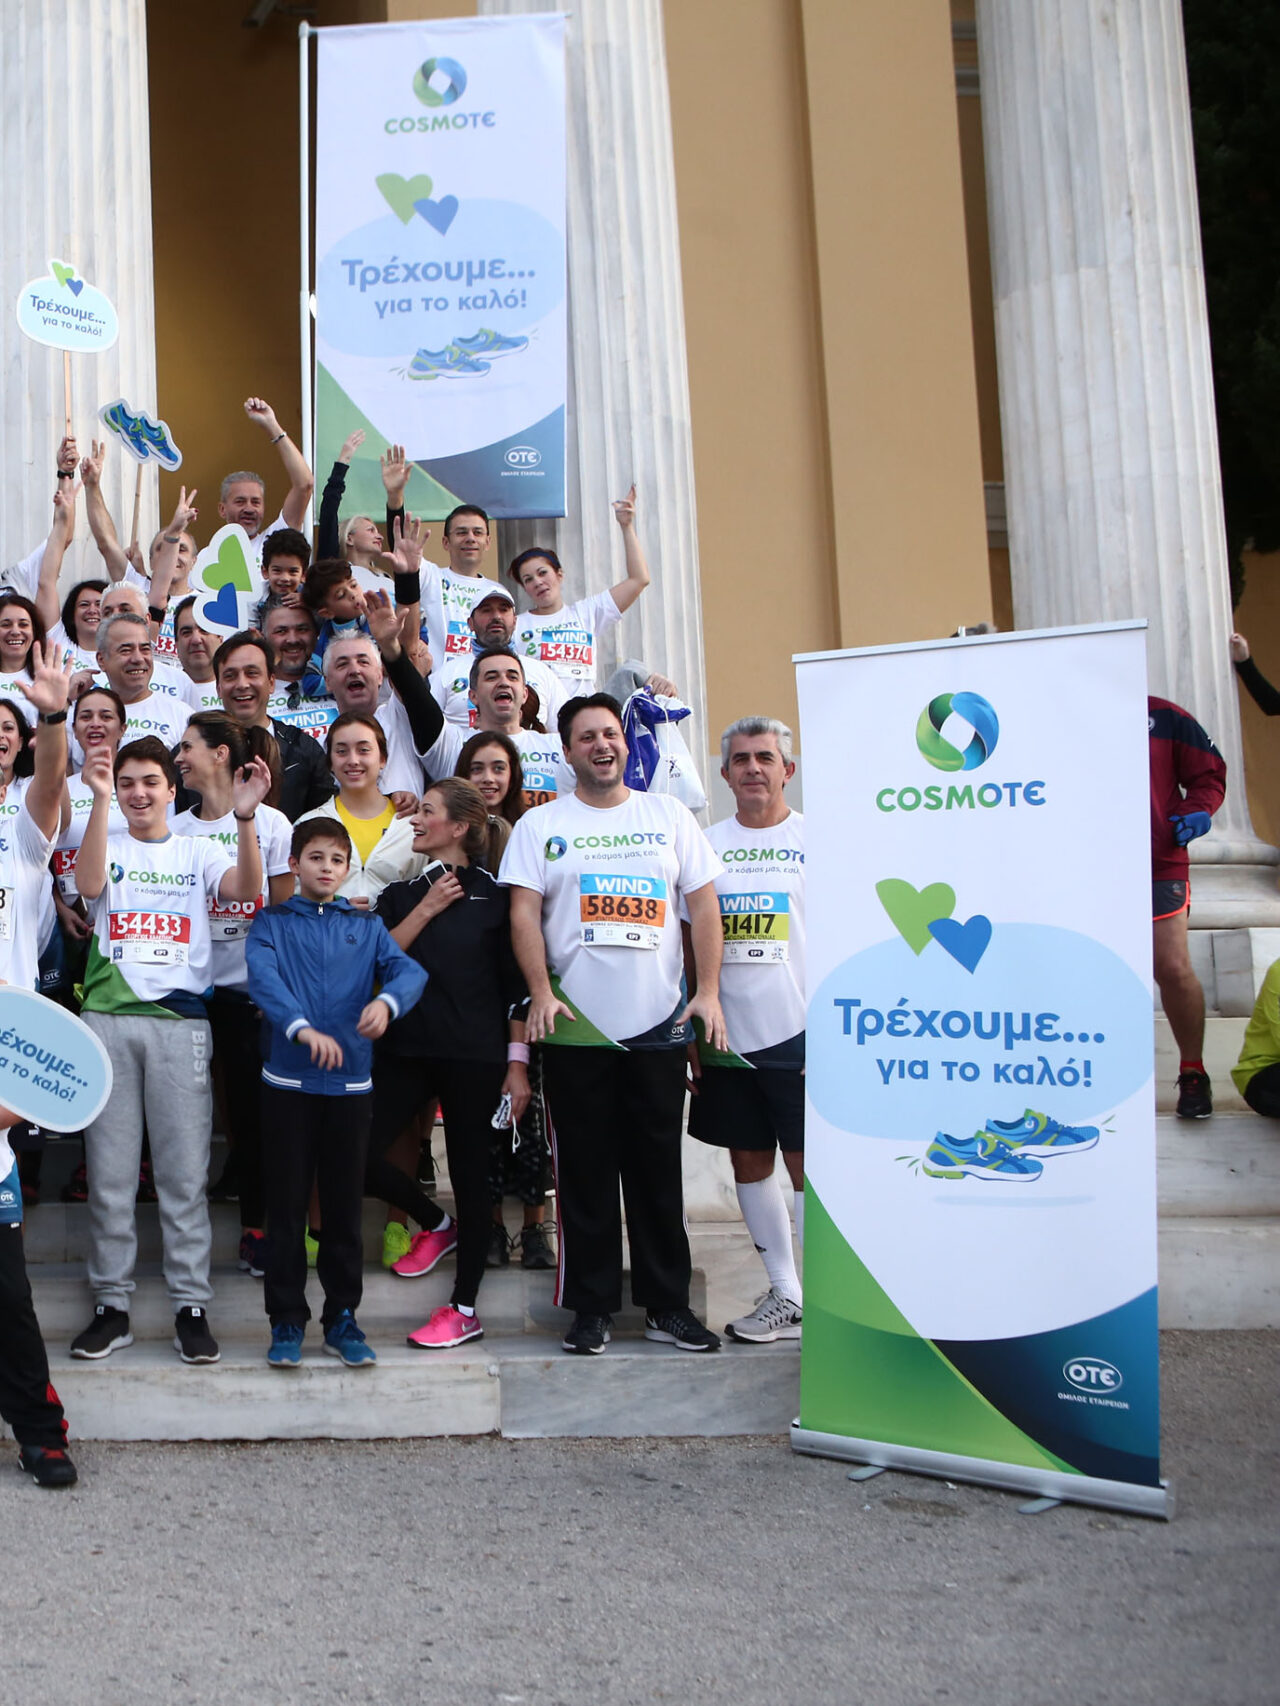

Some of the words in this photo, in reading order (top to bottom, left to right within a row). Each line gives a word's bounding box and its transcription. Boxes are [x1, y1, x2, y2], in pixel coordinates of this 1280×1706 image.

[384, 111, 496, 134] COSMOTE
[341, 256, 535, 292] Τρέχουμε...
[30, 294, 106, 325] Τρέχουμε...
[375, 297, 412, 319] για
[421, 297, 449, 311] το
[459, 289, 527, 311] καλό!
[42, 315, 58, 326] για
[61, 320, 72, 330] το
[75, 323, 102, 337] καλό!
[551, 632, 588, 643] WIND
[126, 718, 170, 735] MOTE
[282, 711, 329, 727] WIND
[521, 752, 560, 764] MOTE
[876, 780, 1047, 813] COSMOTE
[573, 833, 668, 850] COSMOTE
[128, 870, 196, 886] COSMOTE
[595, 876, 653, 895] WIND
[587, 895, 658, 920] 58638
[722, 894, 774, 912] WIND
[117, 913, 182, 937] 54433
[721, 913, 776, 935] 51417
[833, 996, 1106, 1051] Τρέχουμε...
[12, 1063, 29, 1079] το
[31, 1073, 77, 1102] καλό!
[876, 1058, 929, 1085] για
[941, 1060, 981, 1083] το
[993, 1055, 1092, 1088] καλό!
[1068, 1363, 1116, 1387] OTE
